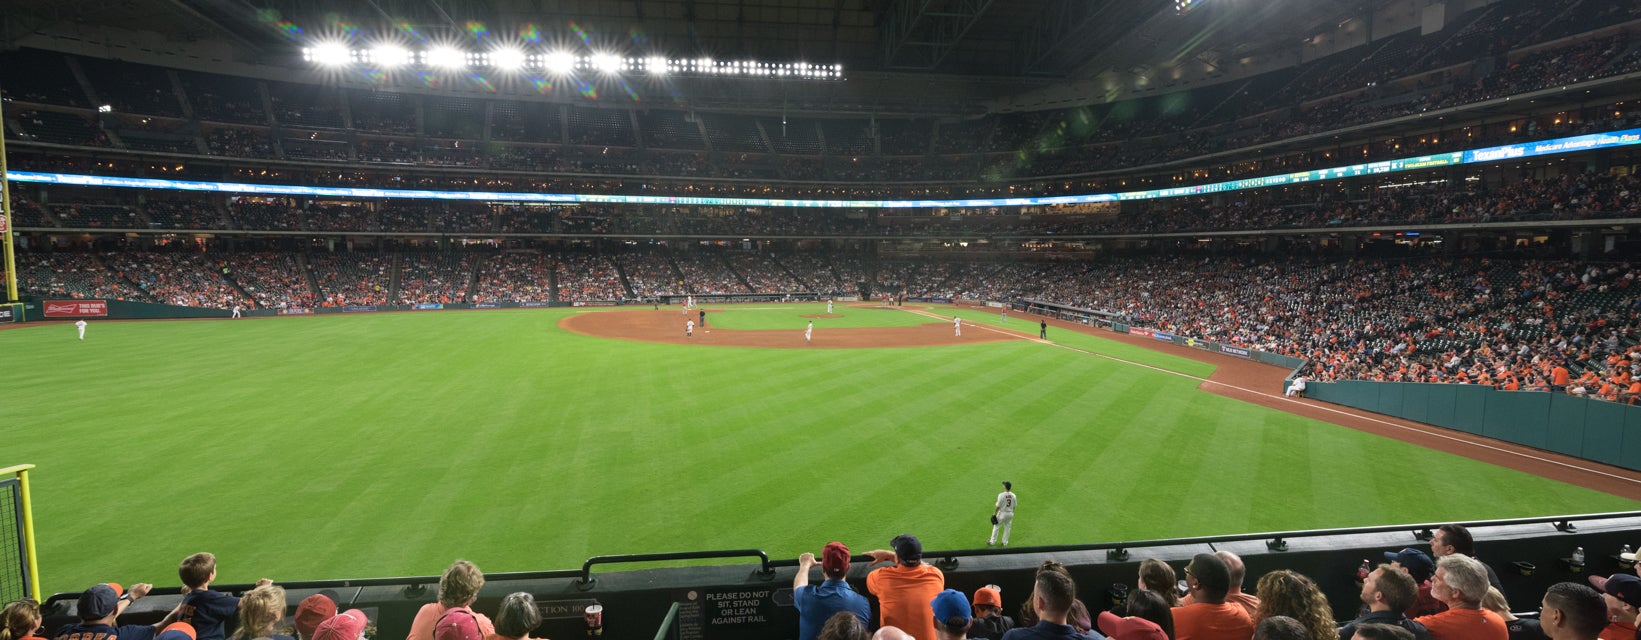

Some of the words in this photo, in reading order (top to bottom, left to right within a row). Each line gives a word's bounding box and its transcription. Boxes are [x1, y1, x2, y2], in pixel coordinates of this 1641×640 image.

[1473, 146, 1524, 160] TexanPlus
[1006, 499, 1011, 507] 3
[706, 592, 738, 600] PLEASE
[753, 590, 769, 598] NOT
[717, 601, 732, 609] SIT,
[732, 600, 760, 608] STAND
[539, 605, 568, 614] CTION
[734, 607, 757, 615] LEAN
[711, 616, 746, 625] AGAINST
